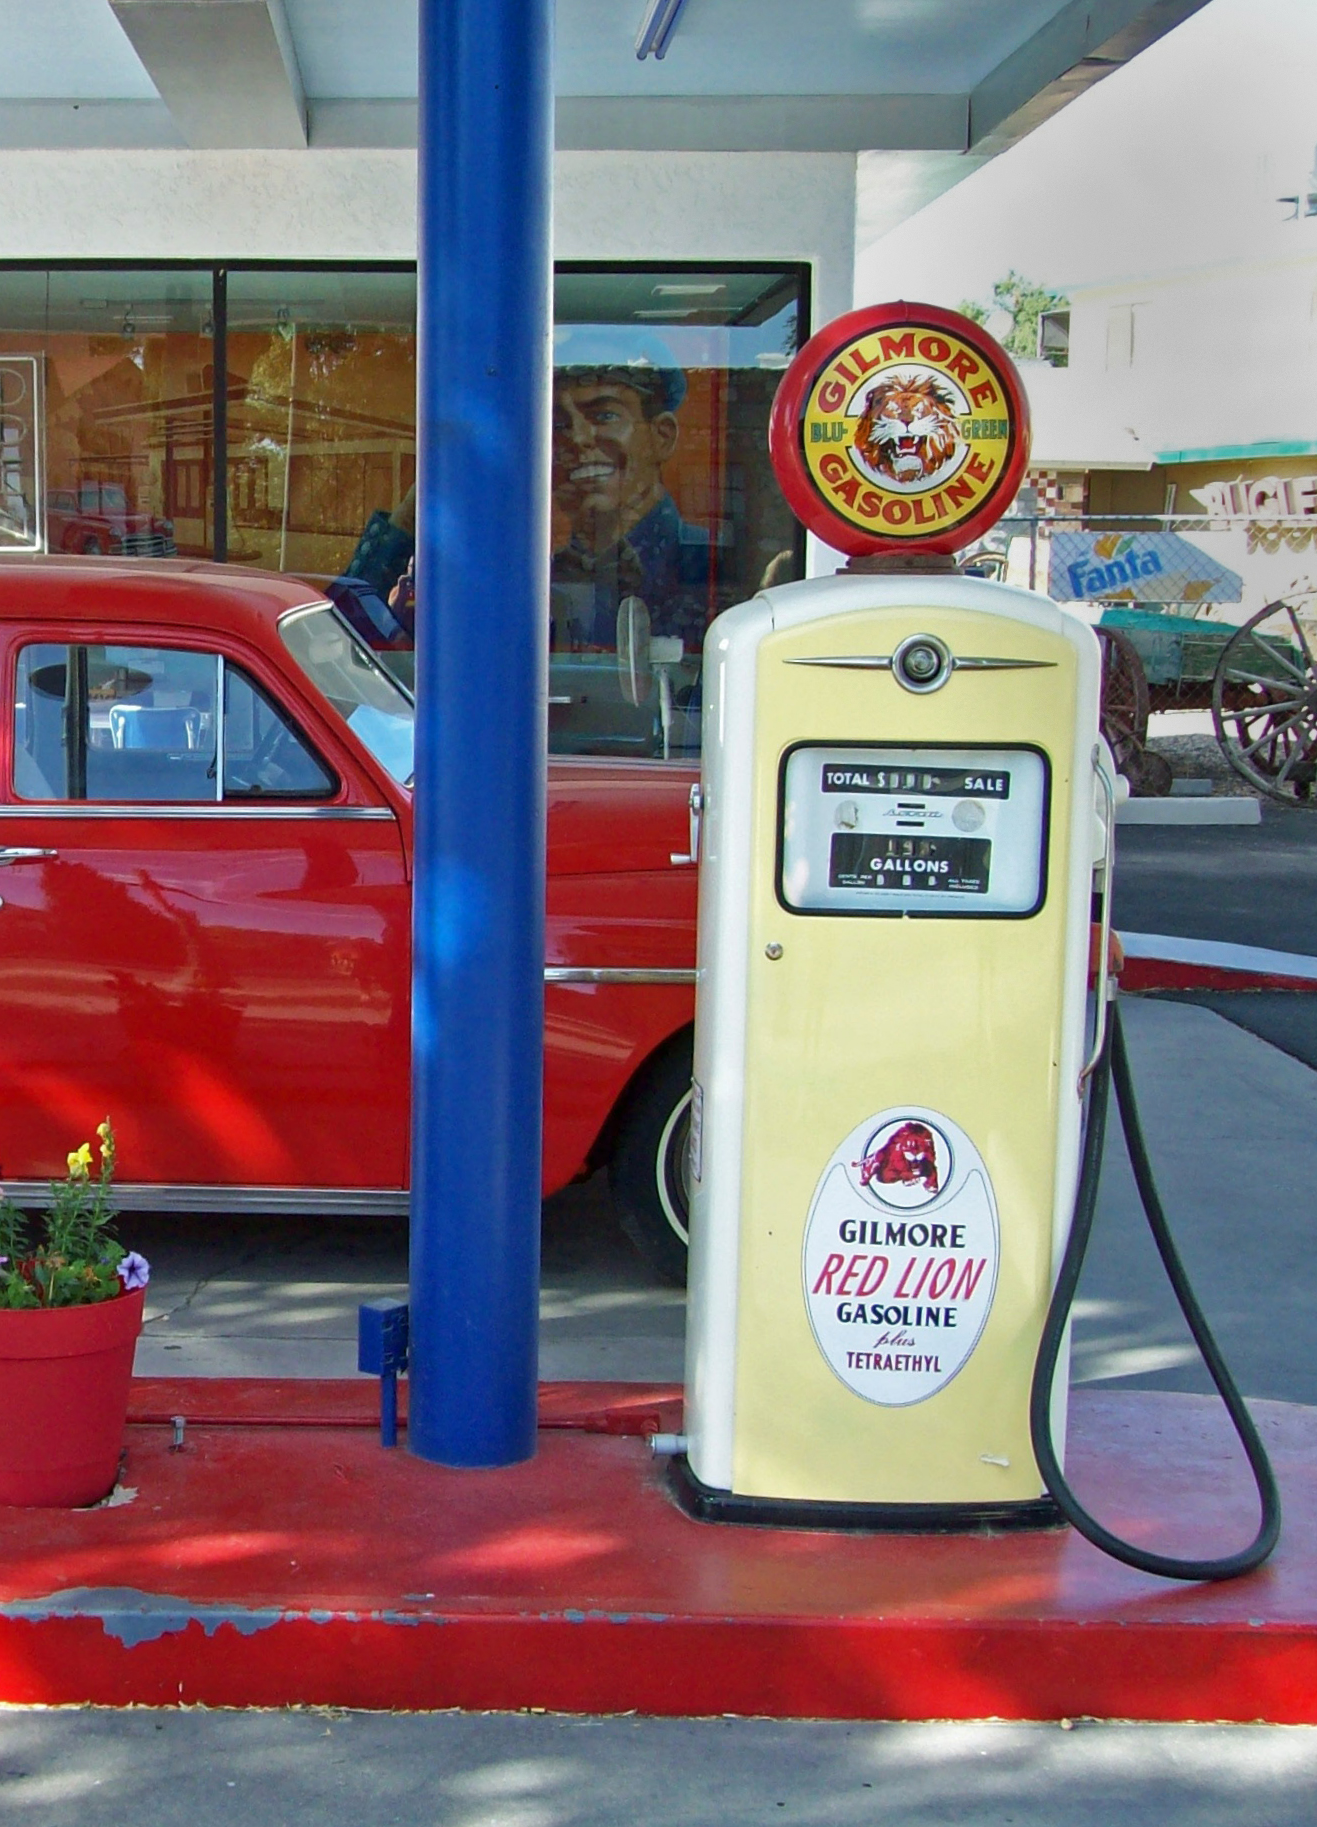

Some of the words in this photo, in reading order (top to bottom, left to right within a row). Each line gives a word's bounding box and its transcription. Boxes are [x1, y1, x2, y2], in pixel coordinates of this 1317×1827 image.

[818, 332, 998, 414] GILMORE
[961, 419, 1008, 441] GREEN
[819, 452, 996, 526] GASOLINE
[1067, 549, 1163, 599] Fanta
[826, 771, 870, 787] TOTAL
[964, 776, 1003, 791] SALE
[869, 858, 949, 874] GALLONS
[838, 1219, 966, 1248] GILMORE
[812, 1253, 889, 1297] RED
[893, 1256, 987, 1301] LION
[836, 1302, 957, 1327] GASOLINE
[872, 1330, 916, 1348] plus
[846, 1351, 942, 1372] TETRAETHYL
